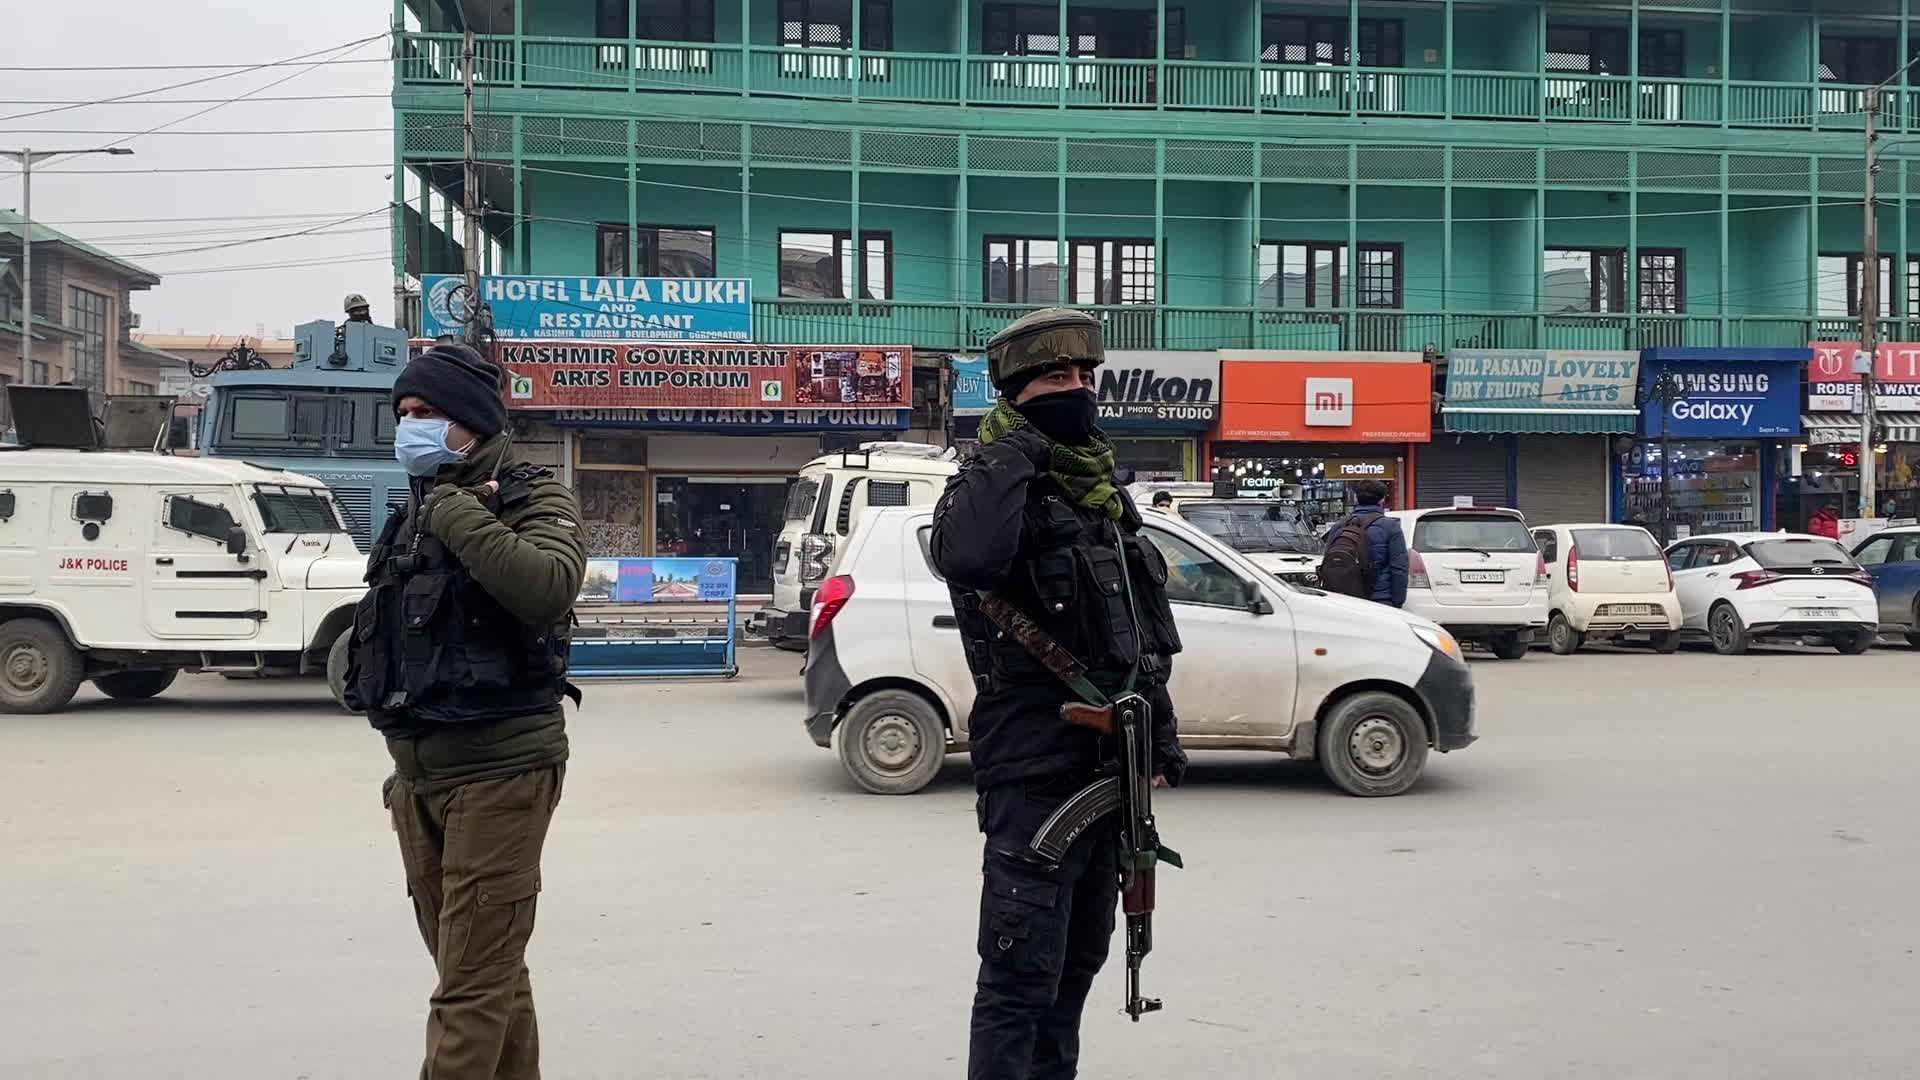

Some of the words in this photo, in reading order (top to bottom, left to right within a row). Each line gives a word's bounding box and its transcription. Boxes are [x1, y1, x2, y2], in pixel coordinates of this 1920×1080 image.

[485, 279, 570, 301] HOTEL
[579, 279, 651, 303] LALA
[661, 279, 746, 304] RUKH
[599, 303, 637, 313] AND
[539, 313, 694, 330] RESTAURANT
[580, 330, 620, 338] TOURISM
[625, 330, 683, 339] DEVELOPMENT
[688, 331, 748, 339] CORPORATION
[502, 346, 618, 365] KASHMIR
[624, 348, 789, 367] GOVERNMENT
[1855, 349, 1920, 376] IT
[1453, 358, 1479, 376] DIL
[1481, 358, 1542, 377] PASAND
[1547, 358, 1637, 379] LOVELY
[550, 369, 611, 388] ARTS
[618, 370, 751, 389] EMPORIUM
[953, 376, 981, 393] NEW
[1099, 368, 1213, 403] Nikon
[1657, 373, 1769, 392] AMSUNG
[1453, 381, 1482, 400] DRY
[1485, 381, 1541, 400] FRUITS
[1559, 384, 1620, 402] ARTS
[1816, 383, 1881, 395] ROBERA
[783, 408, 897, 425] EMPORIUM
[1098, 406, 1123, 418] TAJ
[1127, 406, 1154, 414] PHOTO
[1157, 407, 1213, 420] STUDIO
[1671, 400, 1754, 426] Galaxy
[324, 473, 373, 481] LEYLAND
[1341, 463, 1385, 475] realme
[1242, 476, 1285, 488] realme
[59, 558, 83, 570] J&K
[86, 559, 128, 571] POLICE
